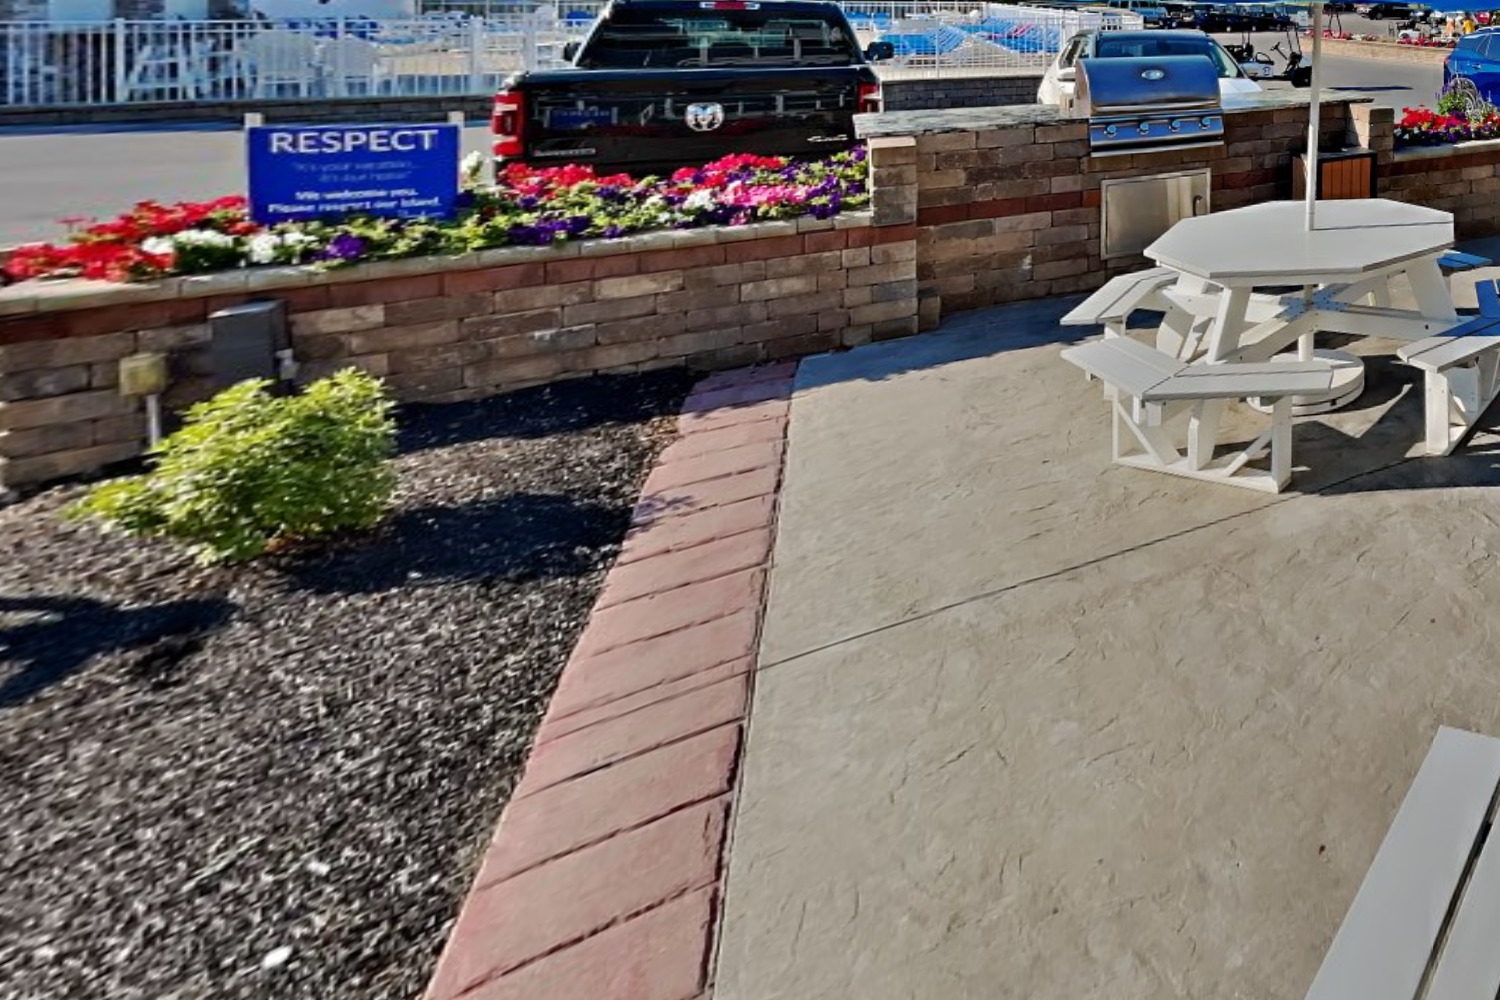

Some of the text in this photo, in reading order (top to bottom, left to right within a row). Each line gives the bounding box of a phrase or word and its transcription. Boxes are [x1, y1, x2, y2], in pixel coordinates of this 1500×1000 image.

[271, 130, 439, 153] RESPECT
[295, 191, 320, 201] We
[321, 189, 388, 201] welcome
[268, 203, 316, 213] Please
[318, 201, 371, 212] respect
